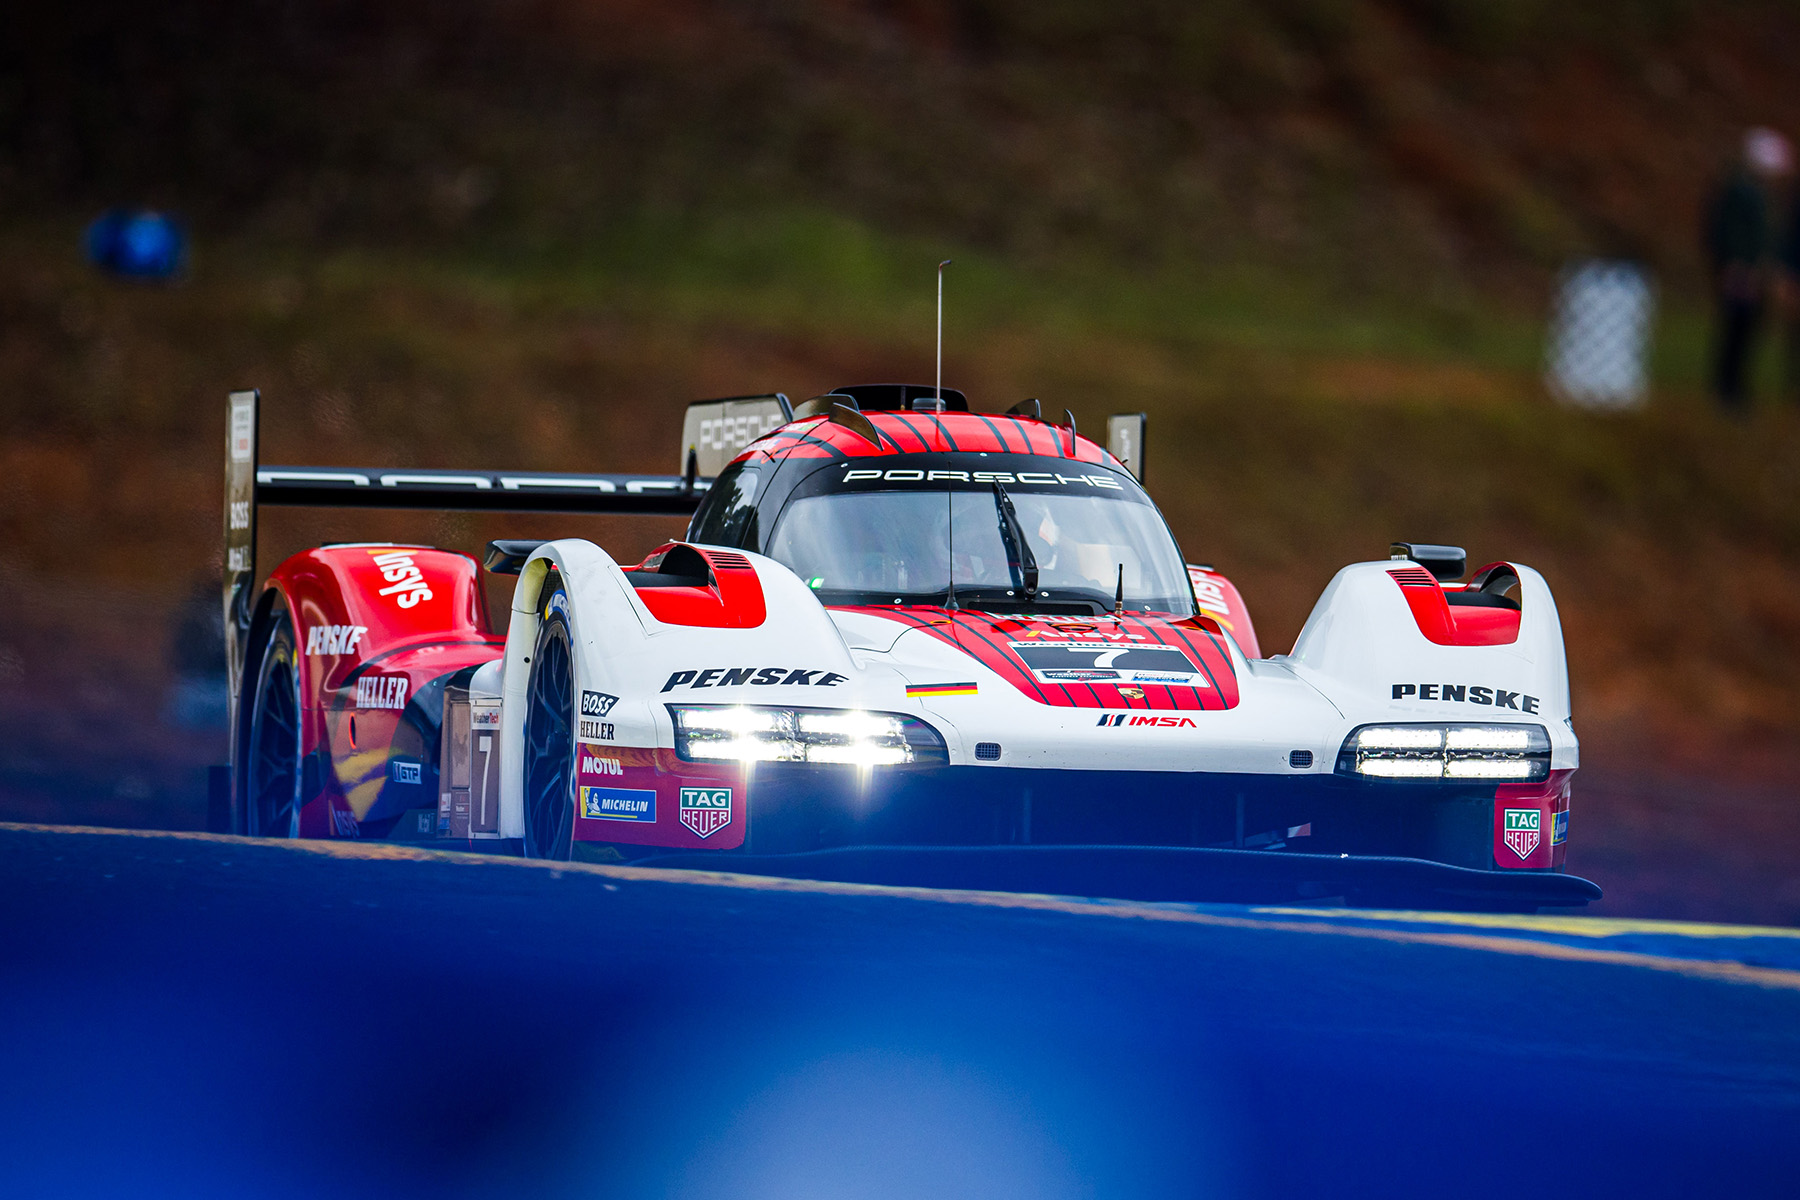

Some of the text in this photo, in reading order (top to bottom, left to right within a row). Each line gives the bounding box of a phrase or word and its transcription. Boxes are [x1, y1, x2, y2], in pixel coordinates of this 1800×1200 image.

[842, 469, 1124, 491] PORSCHE
[305, 625, 368, 656] PENSKE
[1067, 648, 1130, 668] 7
[660, 667, 850, 693] PENSKE
[356, 677, 409, 710] HELLER
[582, 693, 615, 715] BOSS
[1391, 683, 1540, 715] PENSKE
[580, 720, 615, 741] HELLER
[1128, 716, 1197, 728] IMSA
[401, 766, 419, 781] GTP
[582, 756, 624, 776] MOTUL
[479, 736, 492, 826] 7
[601, 798, 649, 812] MICHELIN
[683, 791, 727, 807] TAG
[682, 810, 728, 834] HEUER
[1508, 813, 1538, 828] TAG
[1507, 832, 1538, 855] HEUER
